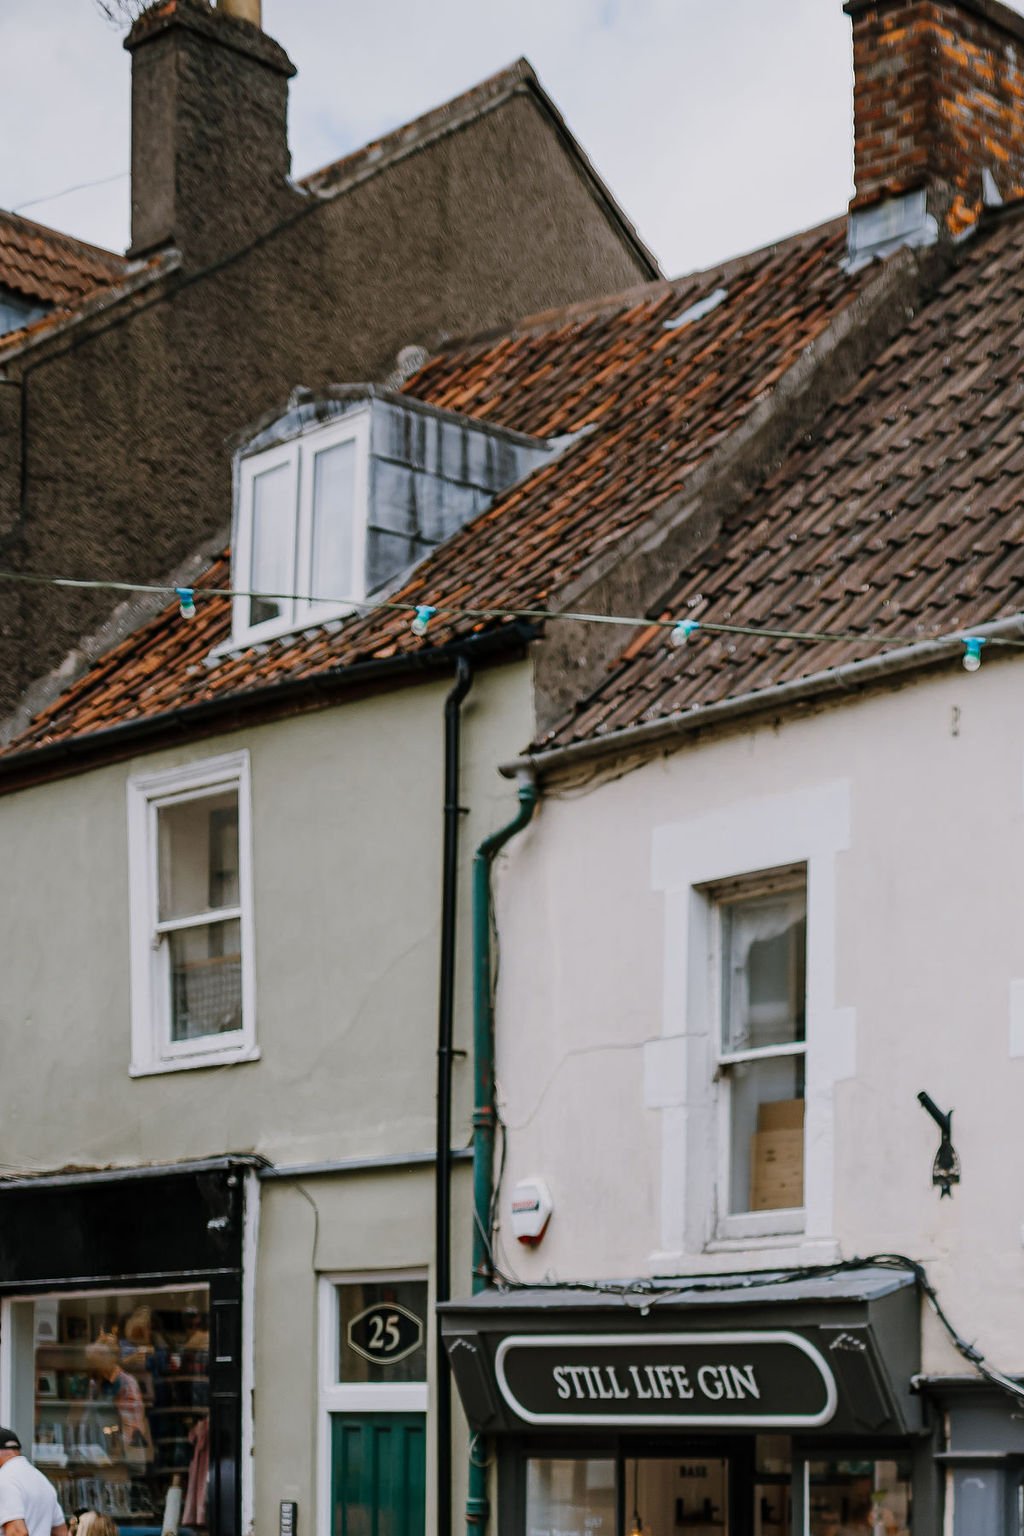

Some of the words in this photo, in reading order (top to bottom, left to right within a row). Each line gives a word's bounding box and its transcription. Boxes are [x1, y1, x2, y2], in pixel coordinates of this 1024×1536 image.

[368, 1315, 401, 1351] 25
[553, 1366, 629, 1399] STILL
[629, 1366, 694, 1399] LIFE
[697, 1365, 760, 1400] GIN
